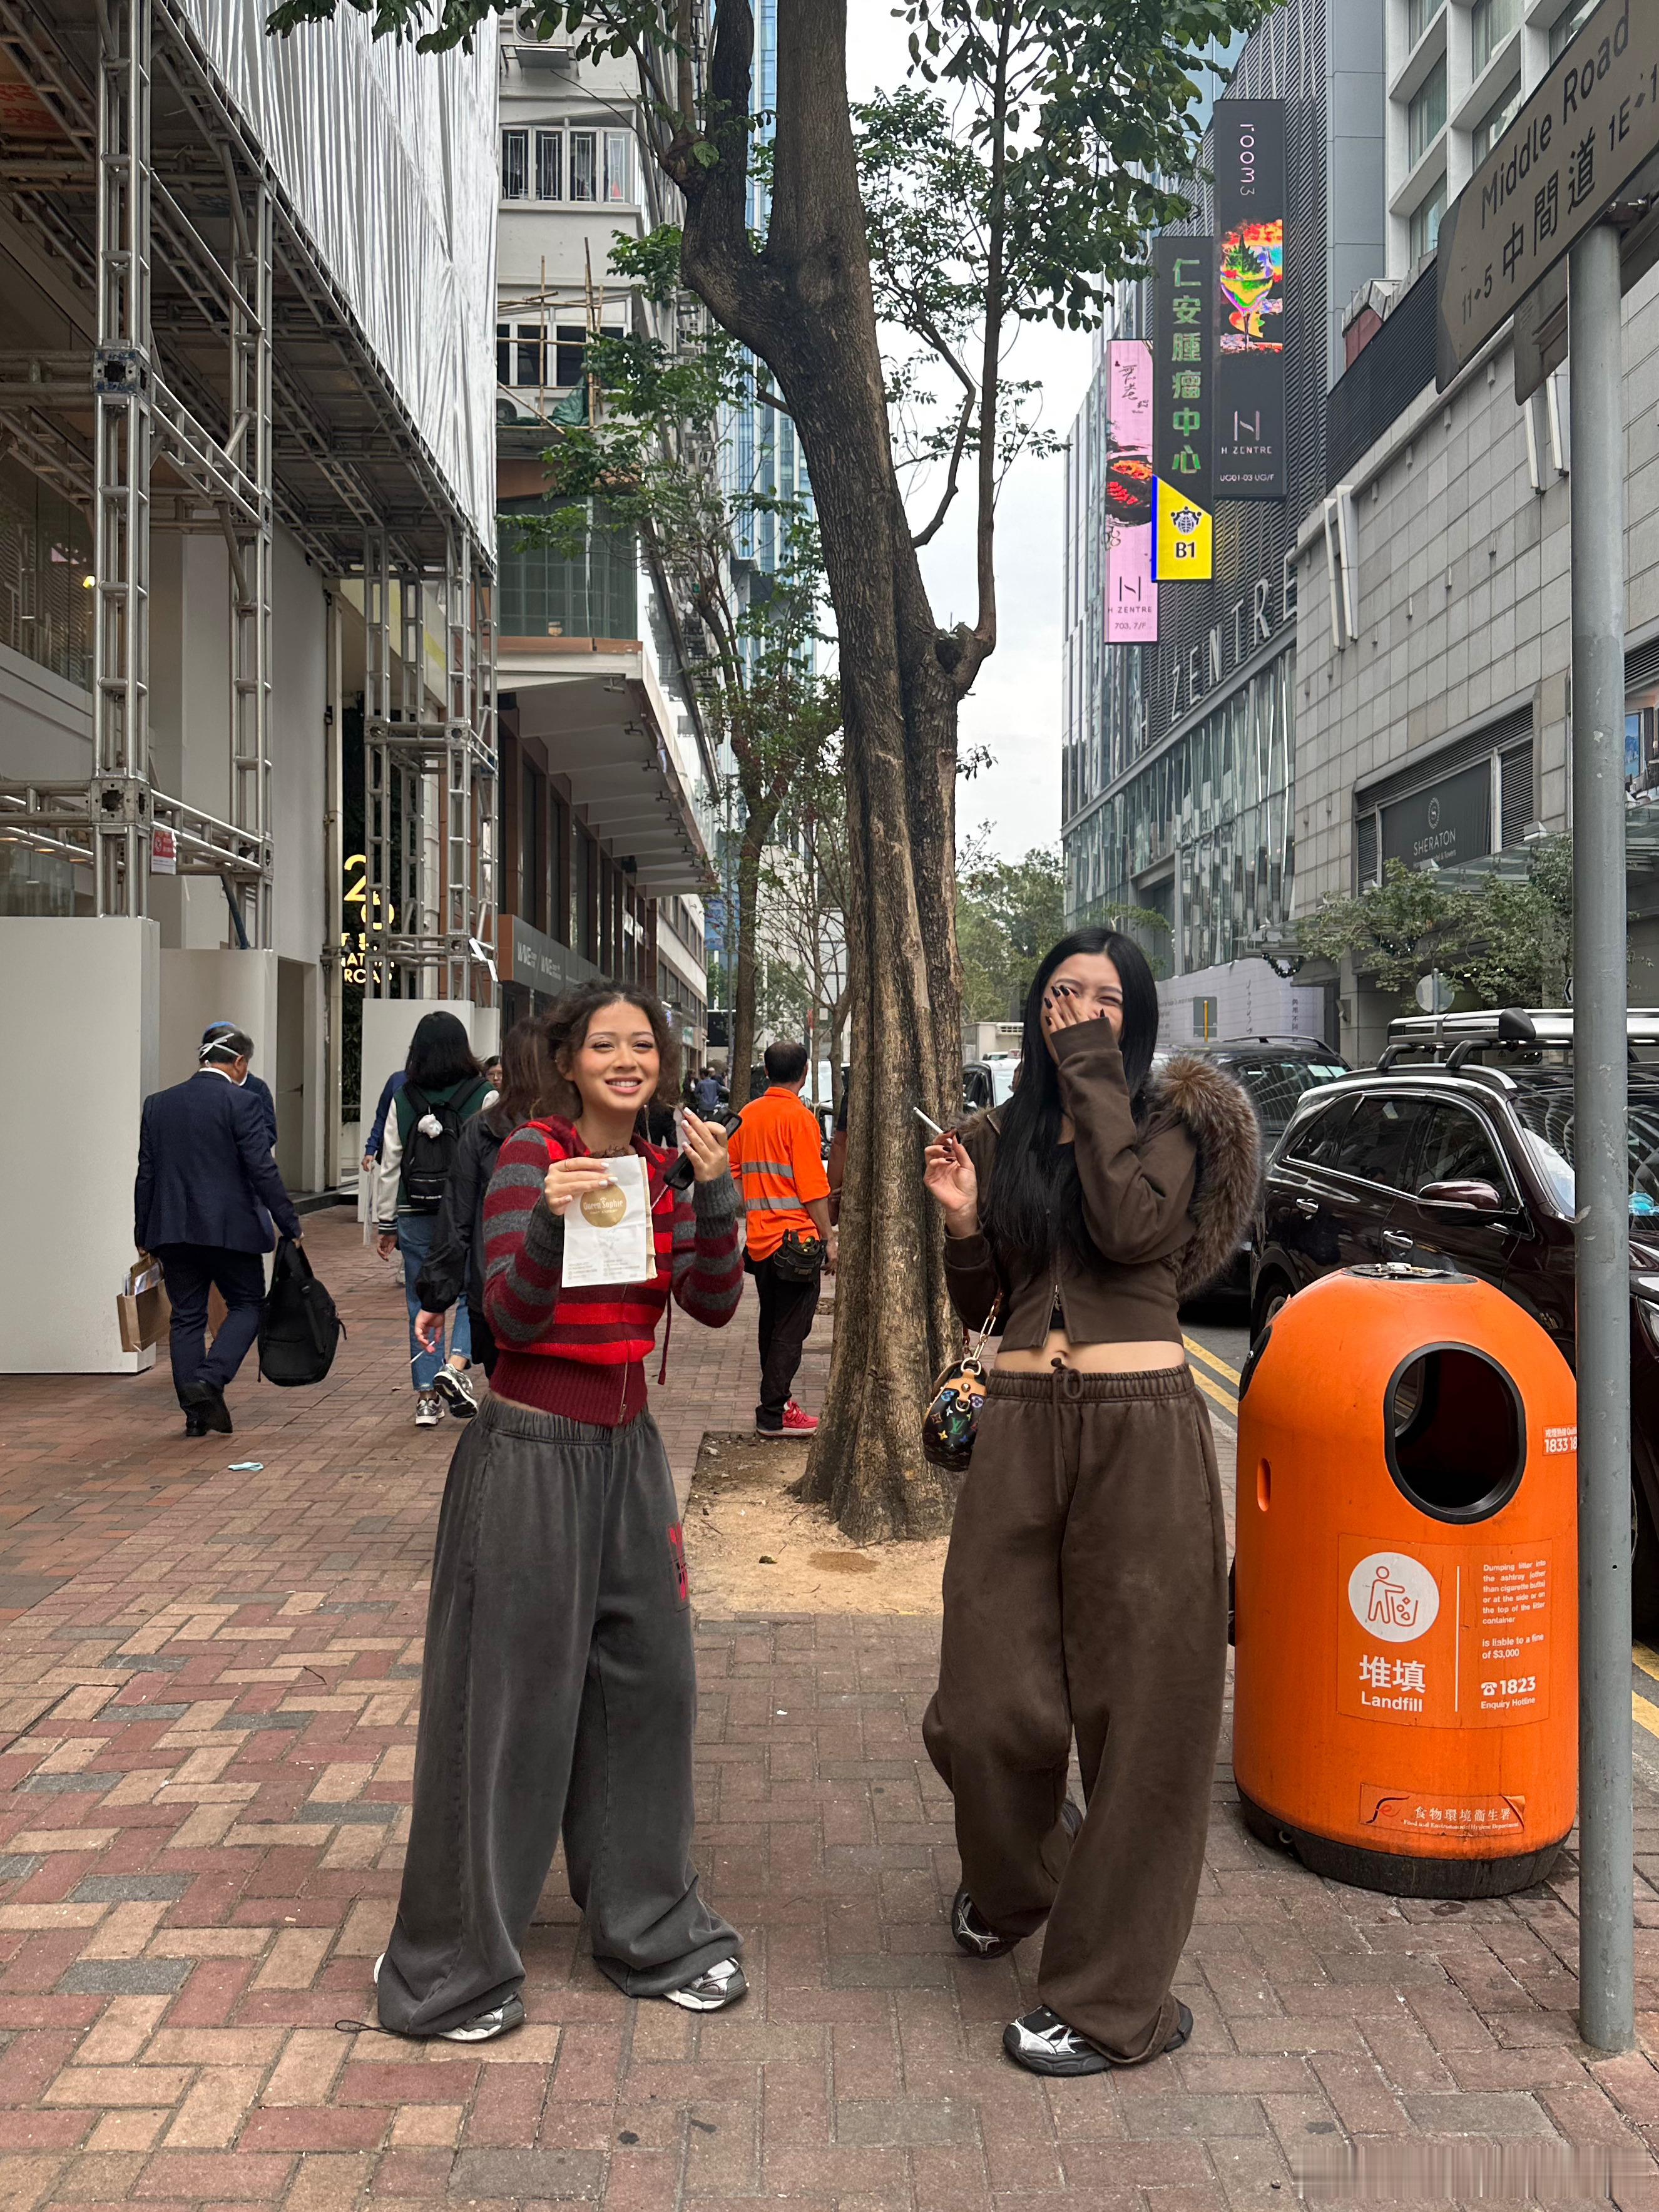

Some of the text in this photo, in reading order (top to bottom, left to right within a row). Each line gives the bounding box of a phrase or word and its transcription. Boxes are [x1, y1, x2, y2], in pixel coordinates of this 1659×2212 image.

[1482, 0, 1628, 230] Middle Road
[1503, 126, 1595, 284] 中間道
[1172, 259, 1202, 474] 仁安腫瘤中心
[1233, 446, 1272, 454] ZENTRE
[1176, 542, 1195, 558] B1
[1413, 827, 1456, 856] SHERATON
[583, 1199, 623, 1211] Queen Sophie
[1544, 1438, 1568, 1453] 1833
[1501, 1583, 1529, 1593] cigarette
[1482, 1638, 1489, 1647] is
[1492, 1637, 1514, 1646] liable
[1531, 1634, 1544, 1642] fine
[1482, 1649, 1519, 1659] of $3,000
[1359, 1654, 1426, 1694] 堆填
[1500, 1676, 1536, 1694] 1823
[1361, 1691, 1422, 1712] Landfill
[1481, 1697, 1536, 1709] Enquiry Hotline
[1431, 1821, 1469, 1830] Environmental
